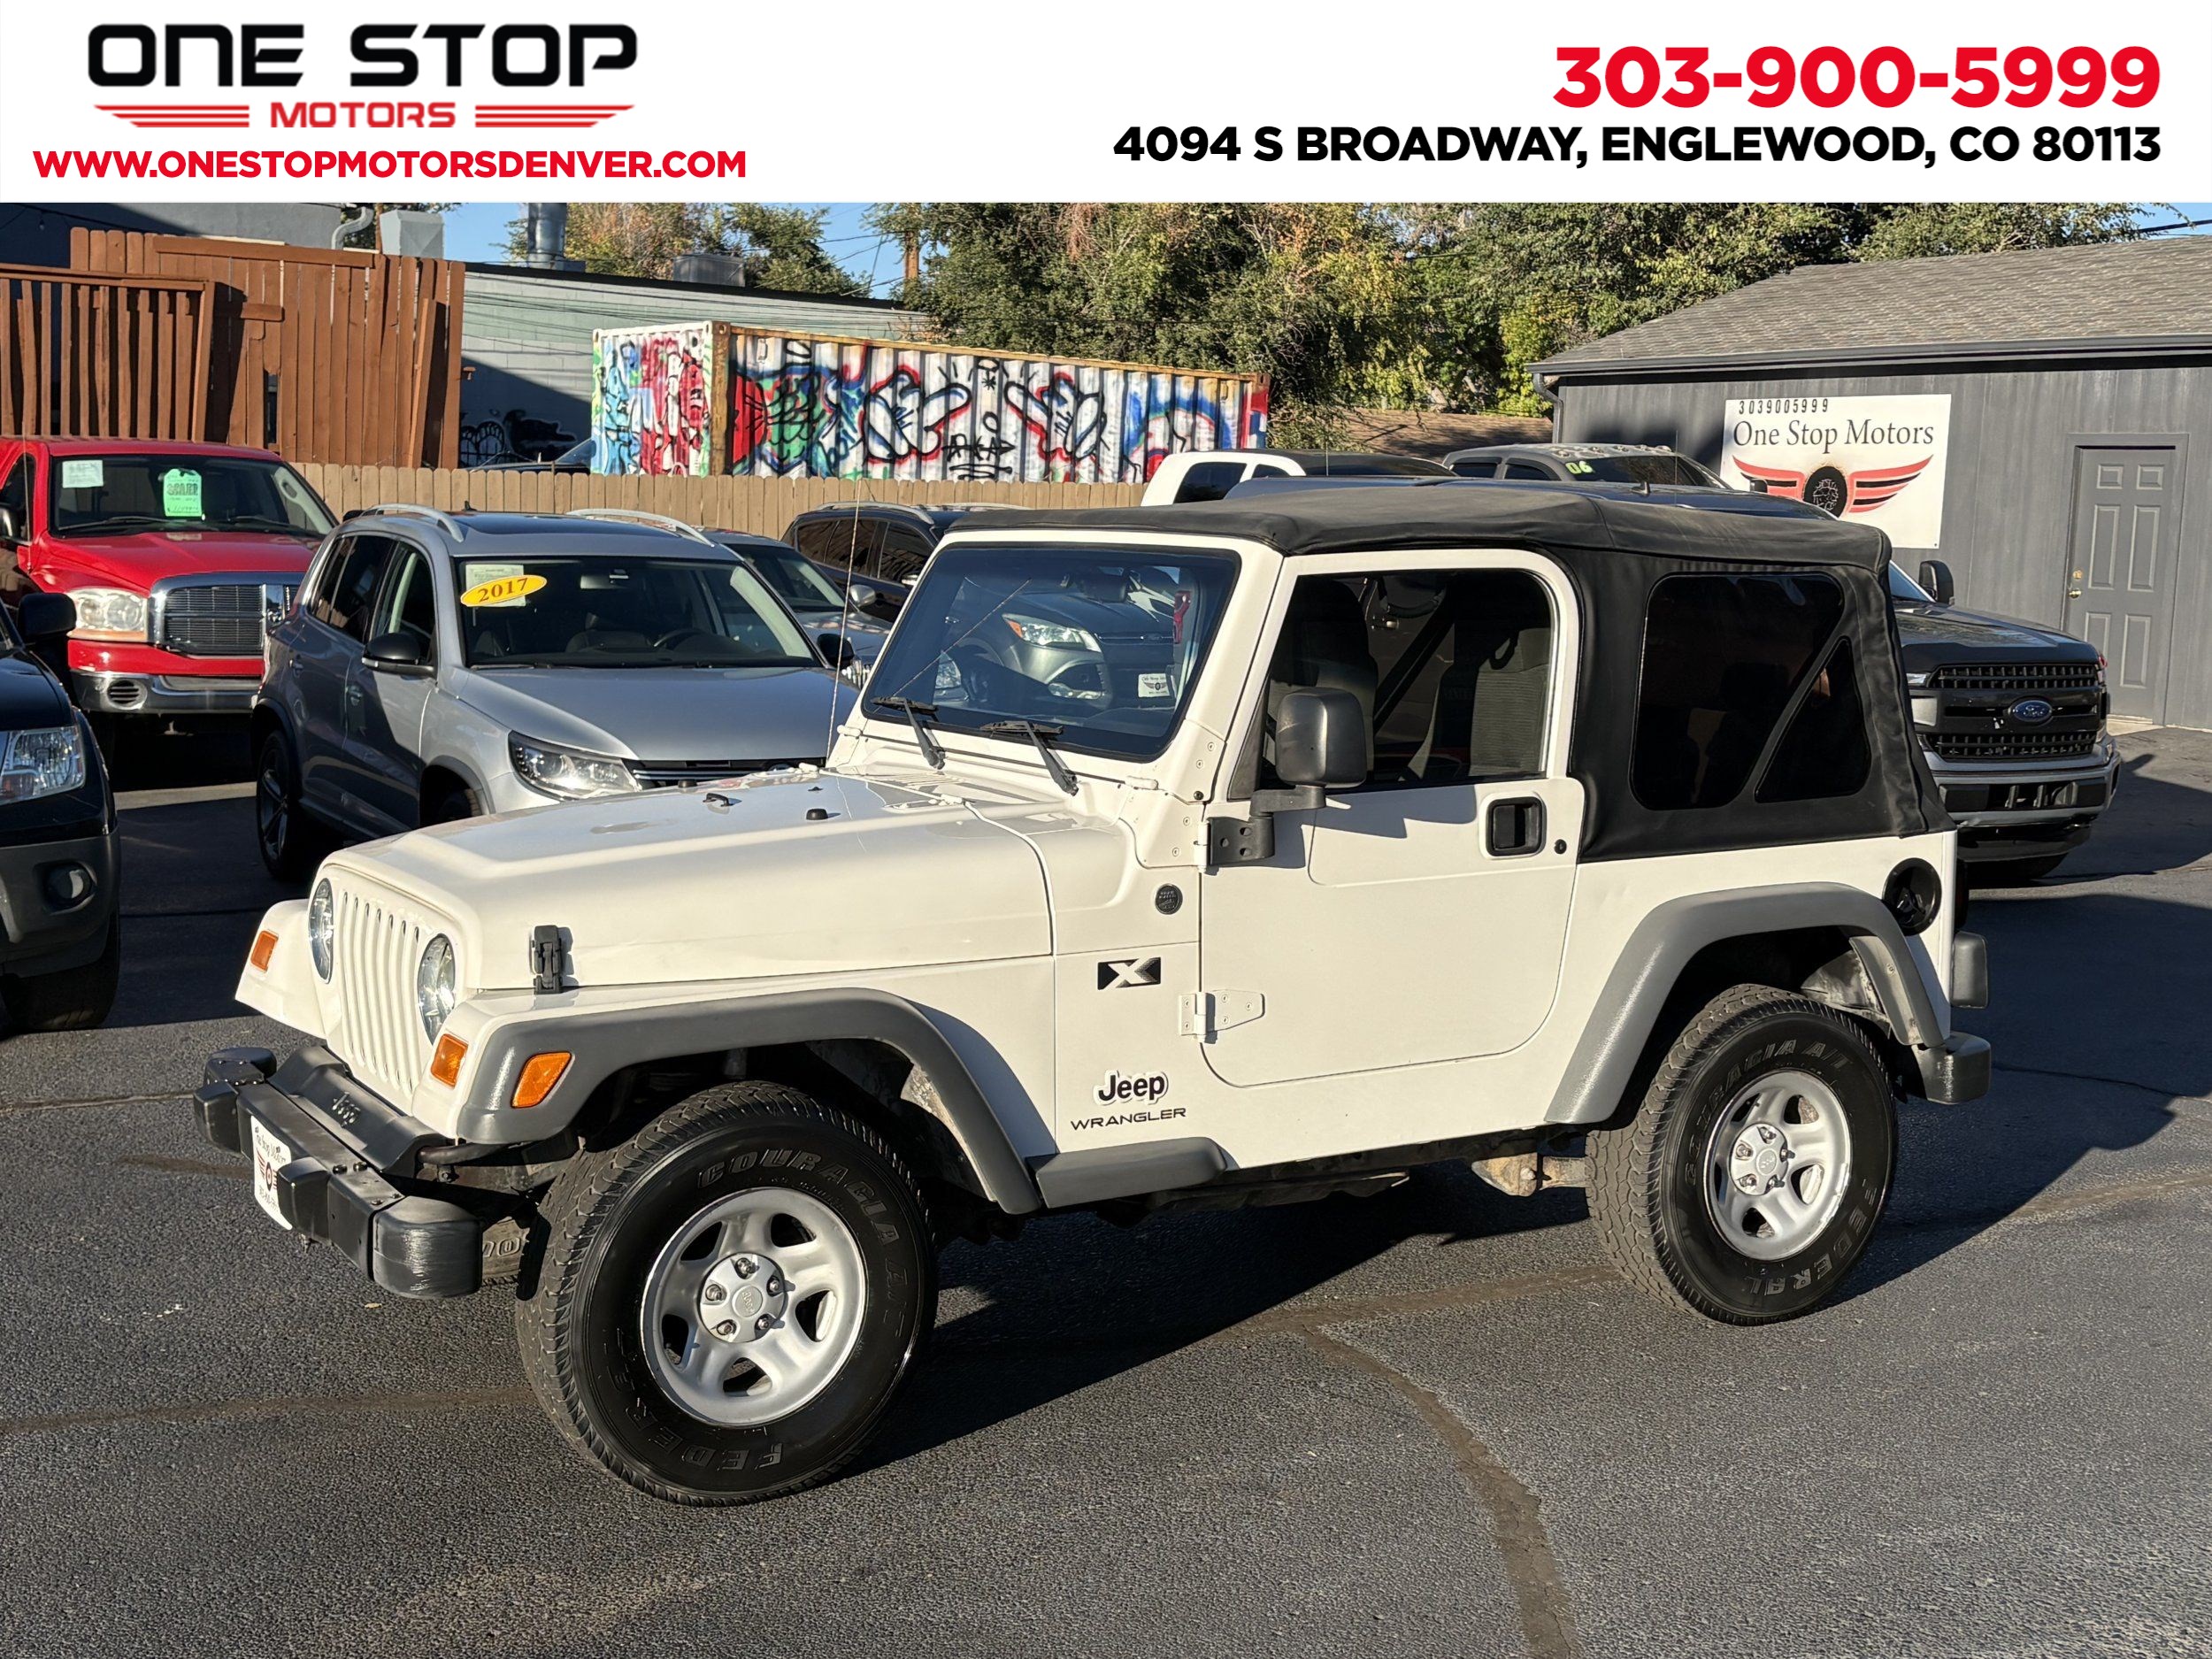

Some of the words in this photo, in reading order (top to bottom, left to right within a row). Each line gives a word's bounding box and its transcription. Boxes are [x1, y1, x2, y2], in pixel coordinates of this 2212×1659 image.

[1739, 398, 1829, 415] 3039005999
[1733, 420, 1780, 446] One
[1786, 419, 1839, 453] Stop
[1844, 419, 1934, 445] Motors
[1565, 460, 1593, 474] 06
[478, 578, 528, 602] 2017
[1097, 1073, 1166, 1102] Jeep
[1071, 1108, 1187, 1130] WRANGLER
[697, 1148, 900, 1245] COURAGIA
